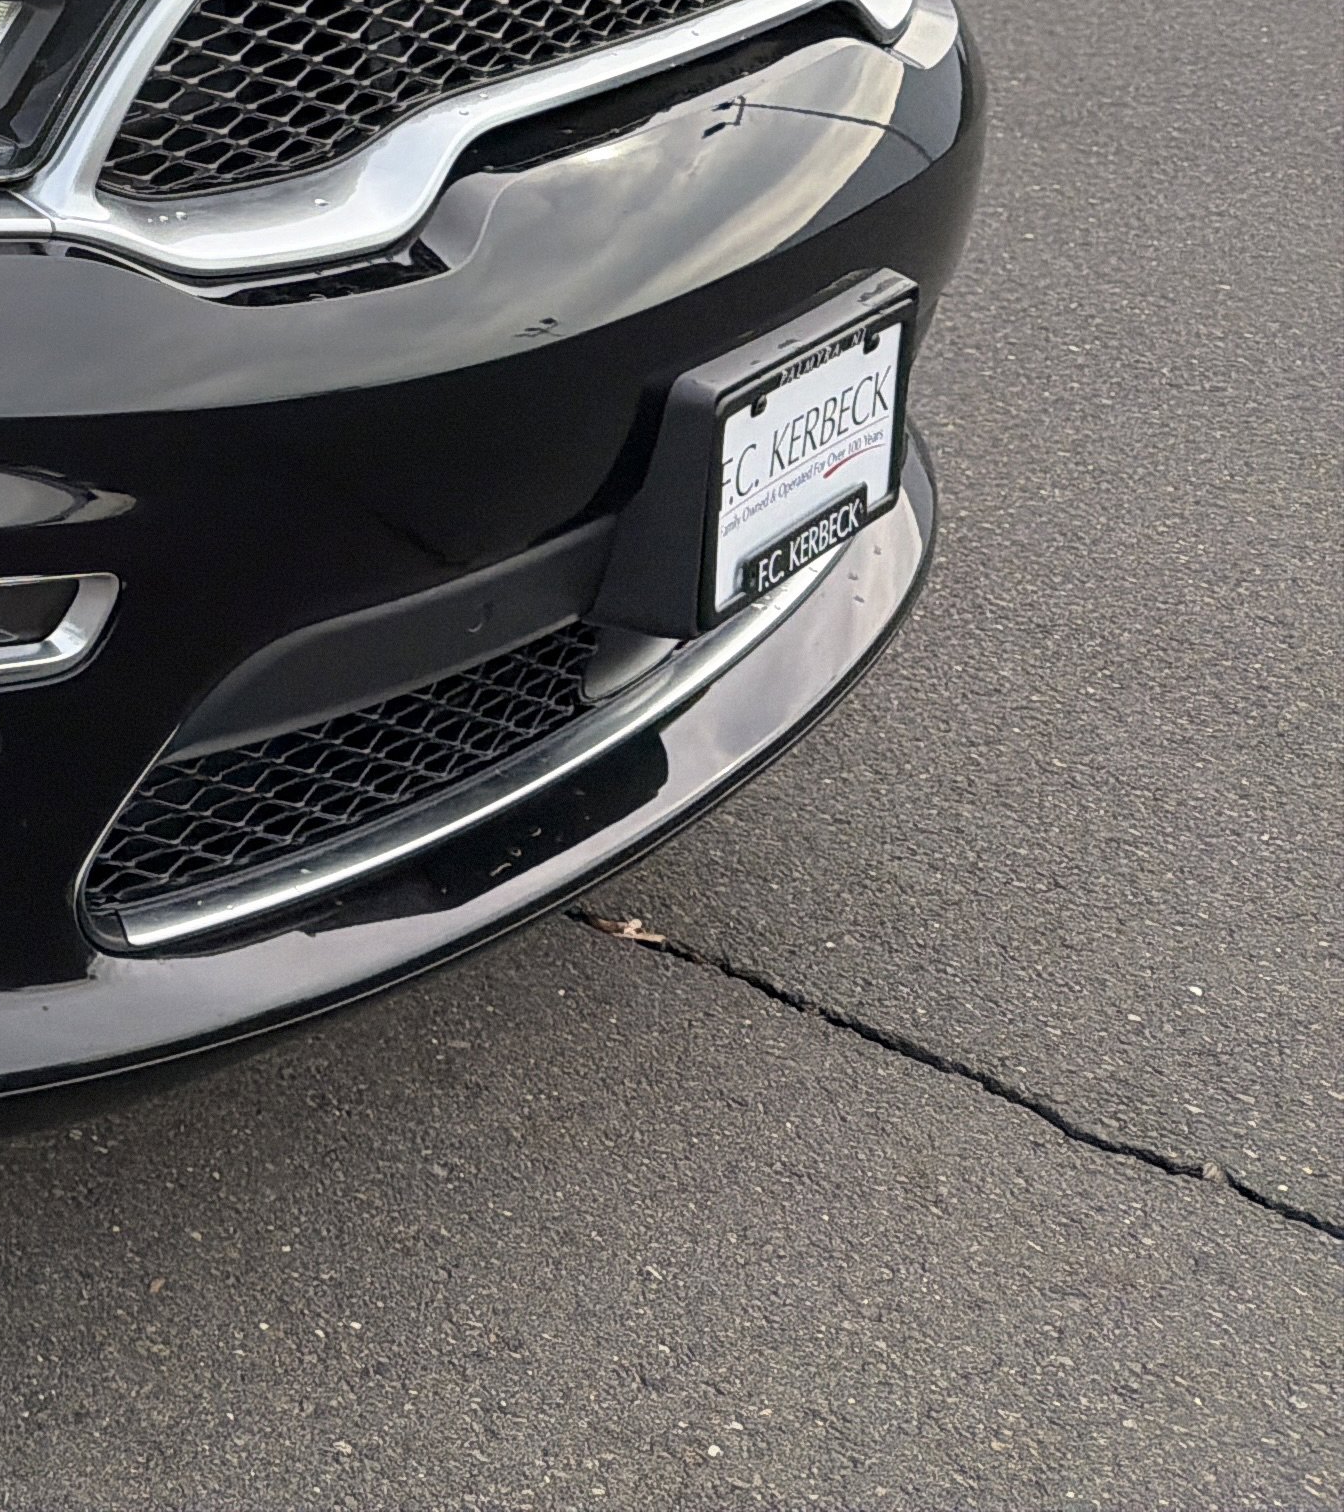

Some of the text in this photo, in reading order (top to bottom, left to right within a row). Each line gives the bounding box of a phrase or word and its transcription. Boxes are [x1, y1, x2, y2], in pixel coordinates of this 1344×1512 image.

[768, 365, 892, 479] KERBECK
[742, 492, 770, 523] Owned
[778, 463, 814, 500] Operated
[814, 459, 827, 478] For
[827, 447, 846, 469] Over
[863, 429, 884, 448] Years
[758, 498, 860, 592] F.C. KERBECK
